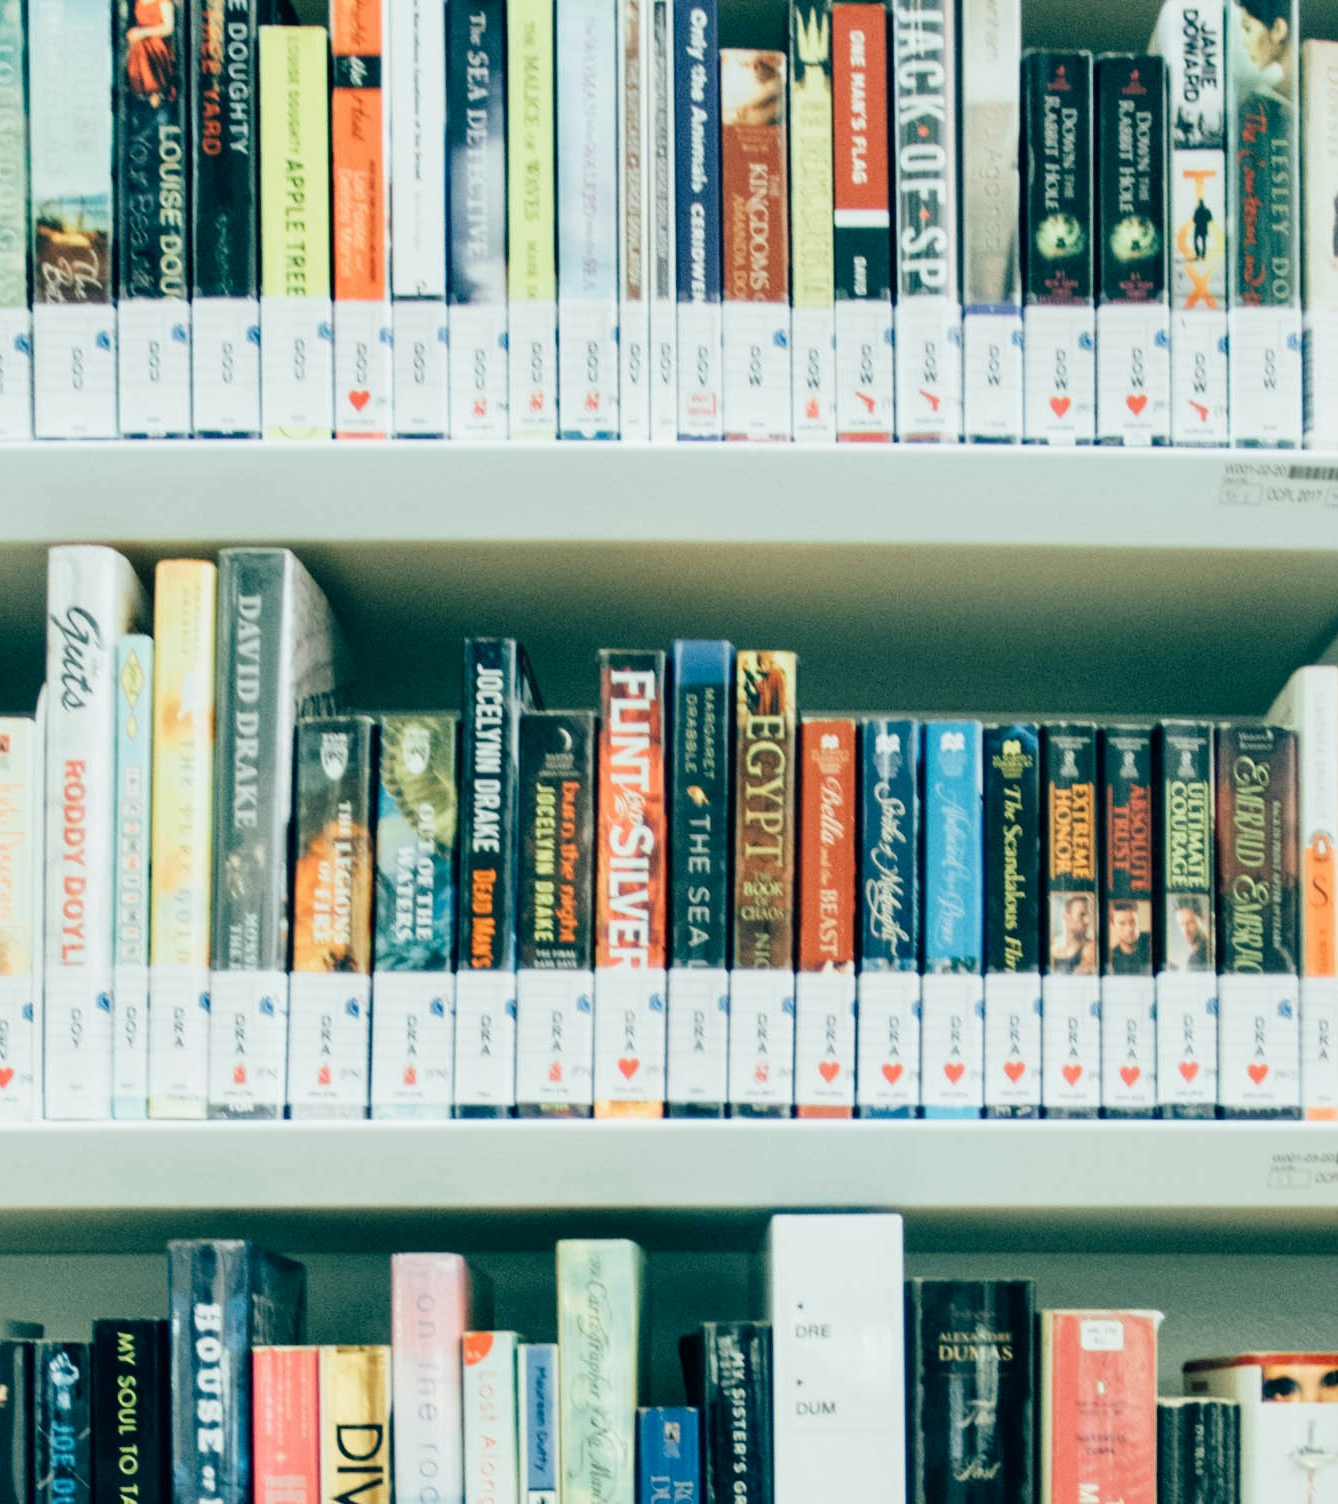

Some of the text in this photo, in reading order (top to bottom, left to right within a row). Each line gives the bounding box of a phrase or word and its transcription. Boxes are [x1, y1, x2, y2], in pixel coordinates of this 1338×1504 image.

[226, 21, 251, 156] DOUGHTY
[466, 51, 487, 100] SEA
[1181, 8, 1200, 104] DOWARD
[1199, 23, 1219, 89] JAMIE
[897, 19, 946, 192] JACK OF
[159, 124, 183, 228] LOUISE
[850, 134, 868, 186] FLAG
[1272, 135, 1291, 239] LESLEY
[285, 158, 308, 297] APPLE TREE
[747, 162, 769, 292] KINGDOMS
[235, 595, 262, 829] DAVID DRAKE
[473, 663, 502, 853] JOCELYNN DRAKE
[610, 670, 655, 969] FLINT SILVER
[745, 709, 785, 869] EGYPT
[1053, 789, 1071, 874] HONOR
[1073, 788, 1093, 879] EXTREME
[62, 759, 87, 967] RODDY DOYL
[1166, 785, 1185, 887] COURAGE
[1186, 786, 1207, 887] ULTIMATE
[819, 888, 839, 957] BEAST
[887, 1015, 899, 1057] DRA
[118, 1331, 134, 1365] MY
[195, 1301, 225, 1453] HOUSE
[794, 1323, 830, 1339] DRE
[938, 1344, 1014, 1363] DUMAS
[50, 1419, 76, 1469] JOE
[118, 1374, 136, 1436] SOUL
[732, 1386, 746, 1475] SISTER'S
[795, 1400, 837, 1416] DUM
[120, 1443, 137, 1479] TO
